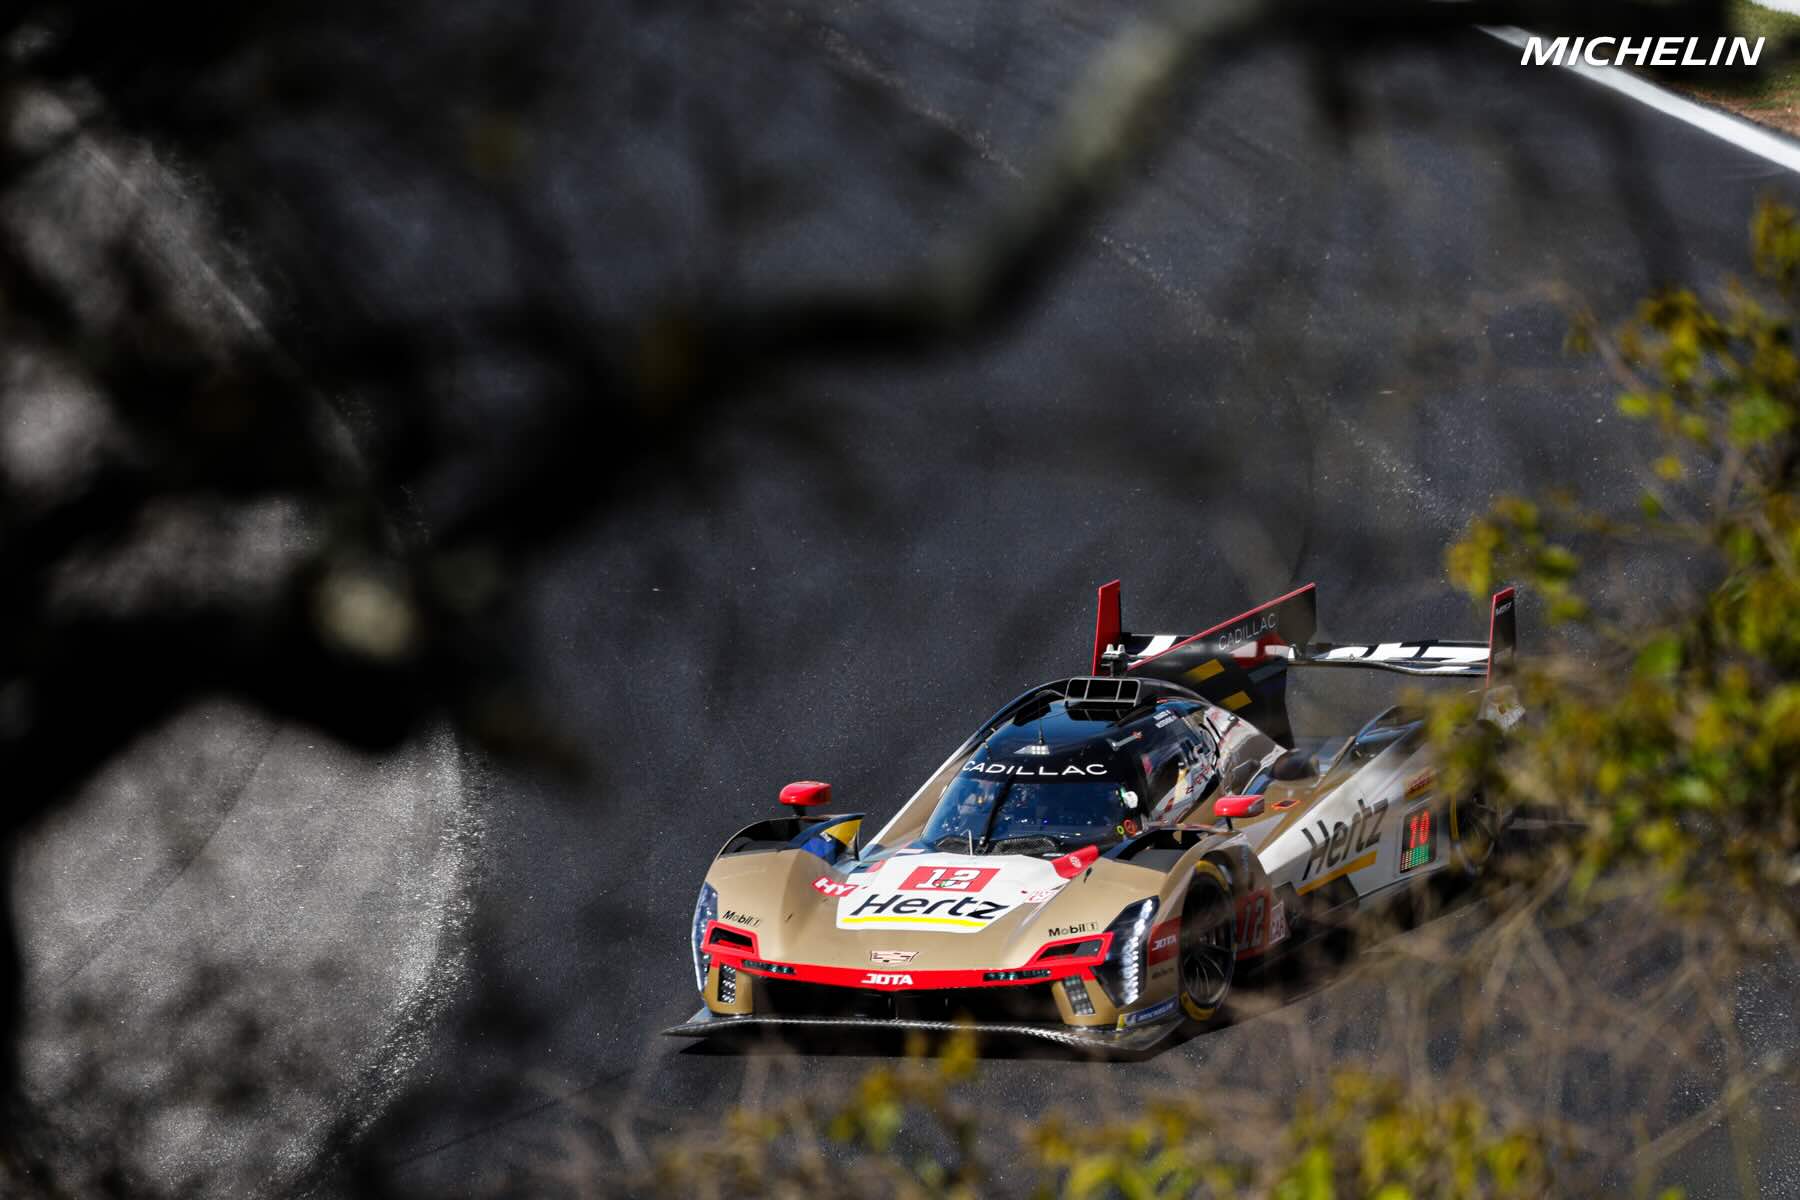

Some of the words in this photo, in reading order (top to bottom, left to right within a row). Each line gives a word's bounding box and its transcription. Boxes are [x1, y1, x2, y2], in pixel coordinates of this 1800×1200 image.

[1218, 613, 1277, 650] CADILLAC
[962, 760, 1108, 776] CADILLAC
[1301, 797, 1389, 881] Hertz
[915, 868, 981, 890] 12
[850, 894, 1009, 920] Hertz
[722, 910, 753, 925] Mobil
[1048, 923, 1086, 937] Mobil
[861, 973, 914, 985] JOTA
